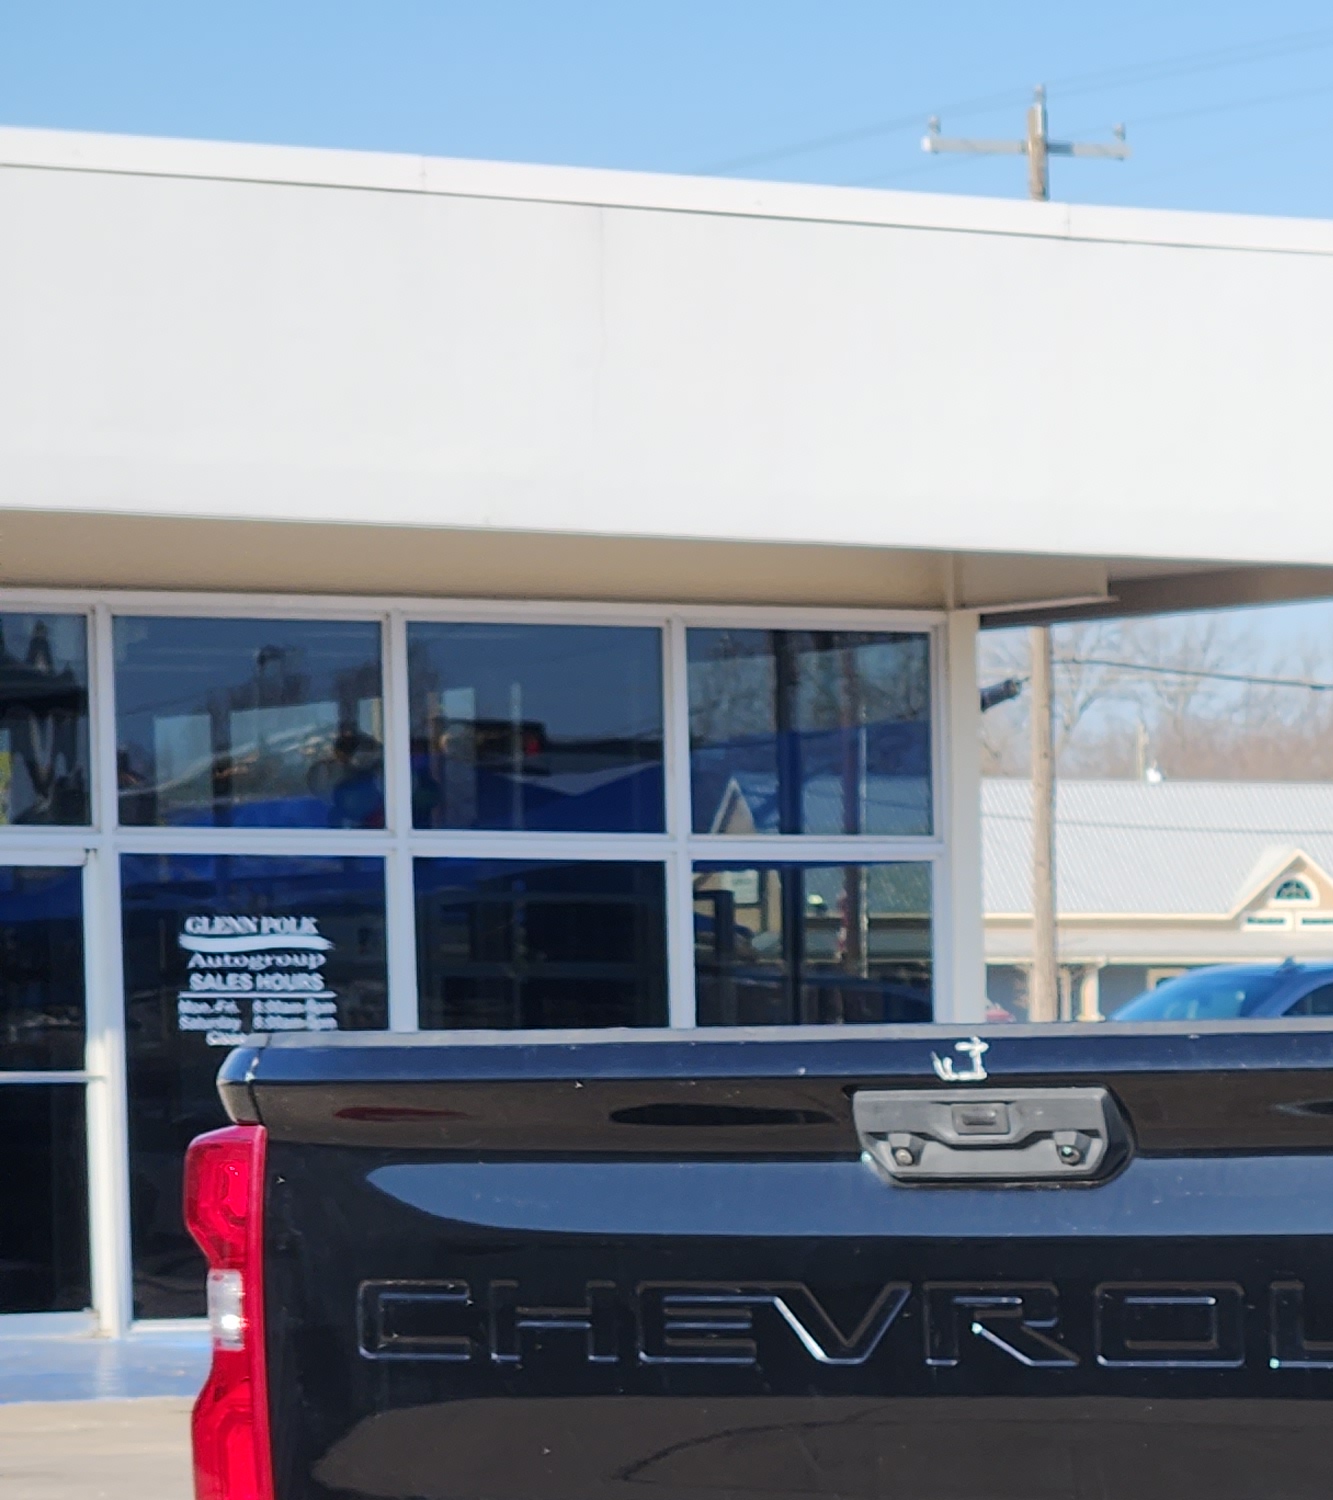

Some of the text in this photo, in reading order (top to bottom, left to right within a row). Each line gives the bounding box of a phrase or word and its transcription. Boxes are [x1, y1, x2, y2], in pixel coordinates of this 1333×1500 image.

[260, 916, 319, 935] POLK
[187, 952, 327, 971] Autogroup
[189, 972, 326, 991] SALES HOURS
